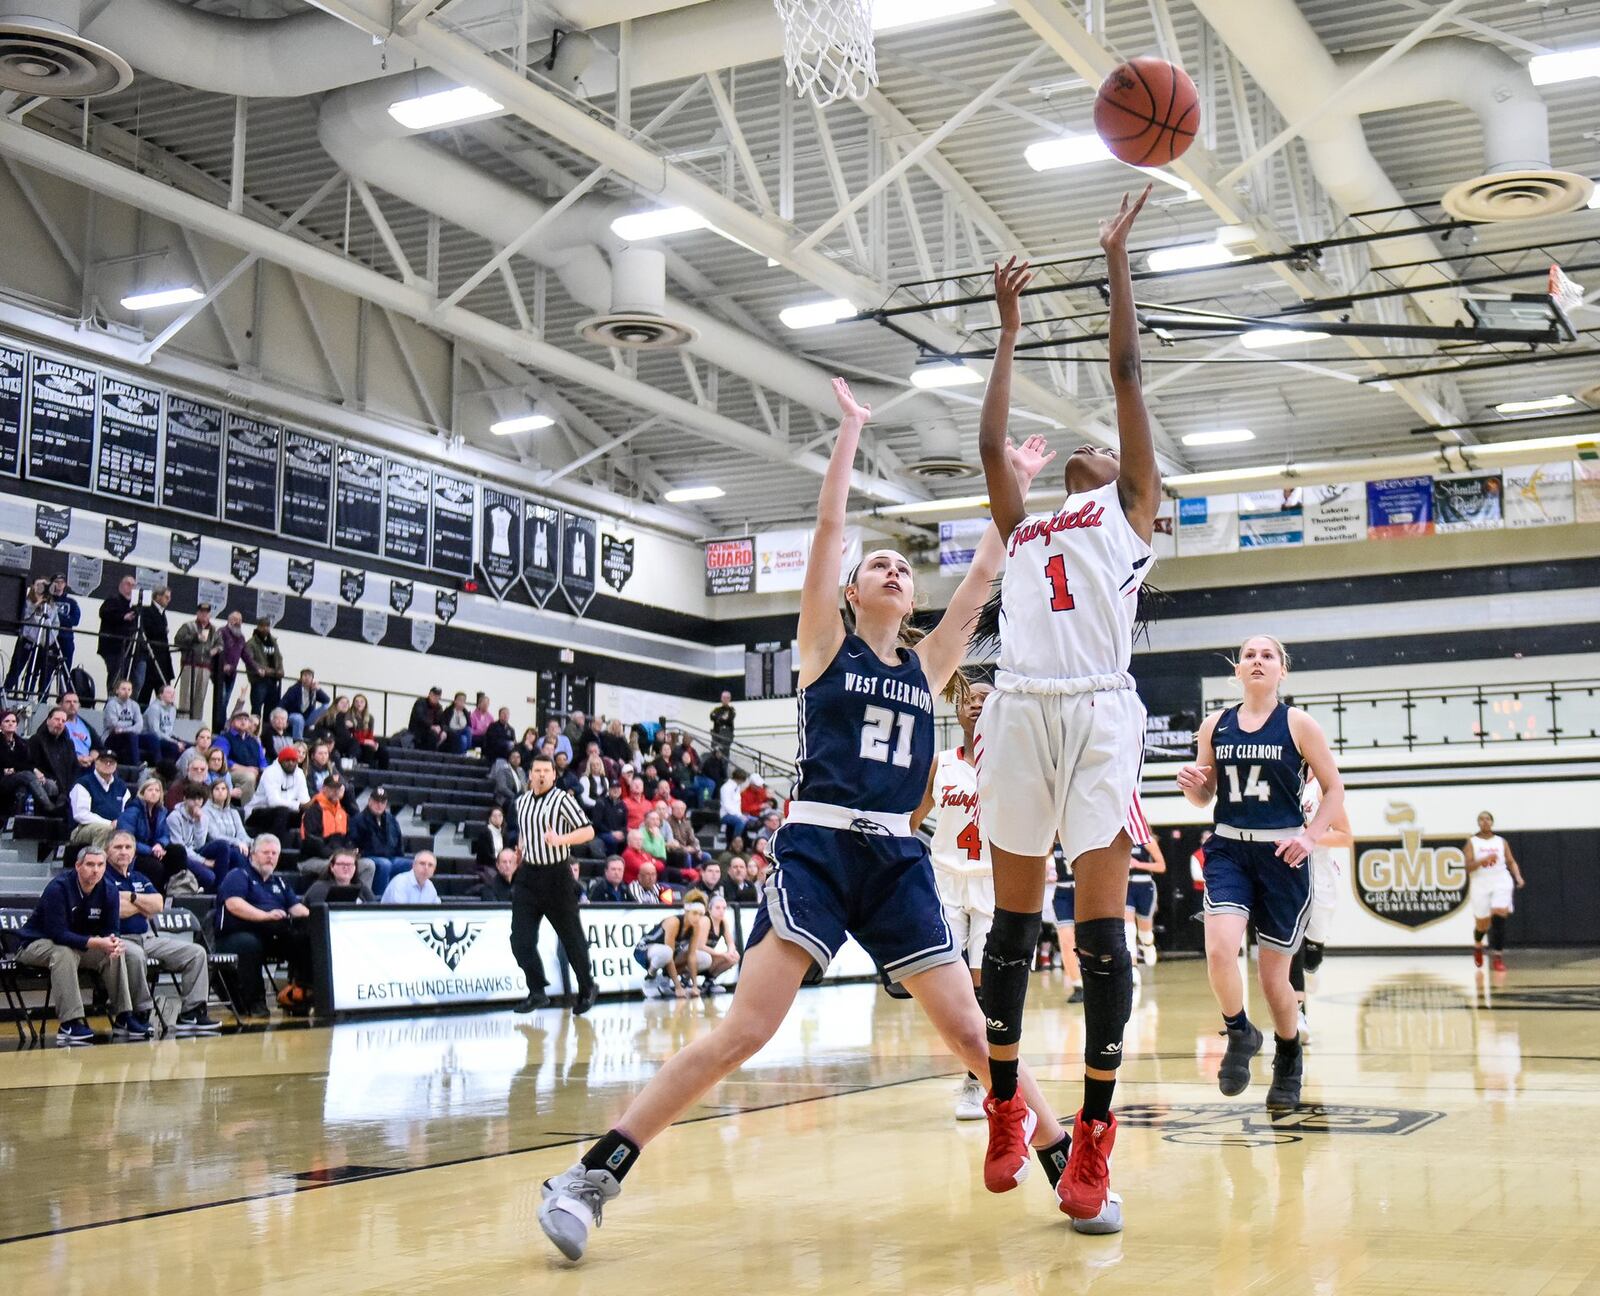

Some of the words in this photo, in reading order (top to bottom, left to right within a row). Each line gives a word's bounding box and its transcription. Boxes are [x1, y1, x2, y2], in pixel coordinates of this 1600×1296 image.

[1009, 501, 1106, 558] Fairfield
[1314, 532, 1358, 541] Basketball
[709, 550, 752, 568] GUARD
[735, 584, 750, 592] Paid
[1044, 553, 1075, 612] 1
[844, 672, 878, 696] WEST
[882, 678, 934, 715] CLERMON
[1147, 715, 1170, 731] AST
[860, 703, 915, 769] 21
[1146, 730, 1193, 746] OSTERS
[1236, 745, 1283, 760] CLERMONT
[1224, 764, 1271, 803] 14
[957, 821, 982, 861] 4
[1359, 846, 1467, 892] GMC
[1366, 891, 1418, 904] GREATER
[1420, 890, 1461, 902] MIAMI
[1376, 901, 1450, 913] CONFERENCE
[0, 916, 28, 930] EAS
[158, 913, 192, 928] EAST
[588, 923, 656, 949] AKOT
[592, 957, 632, 977] IGH
[357, 975, 525, 1001] EASTTHUNDERHAWKS.C
